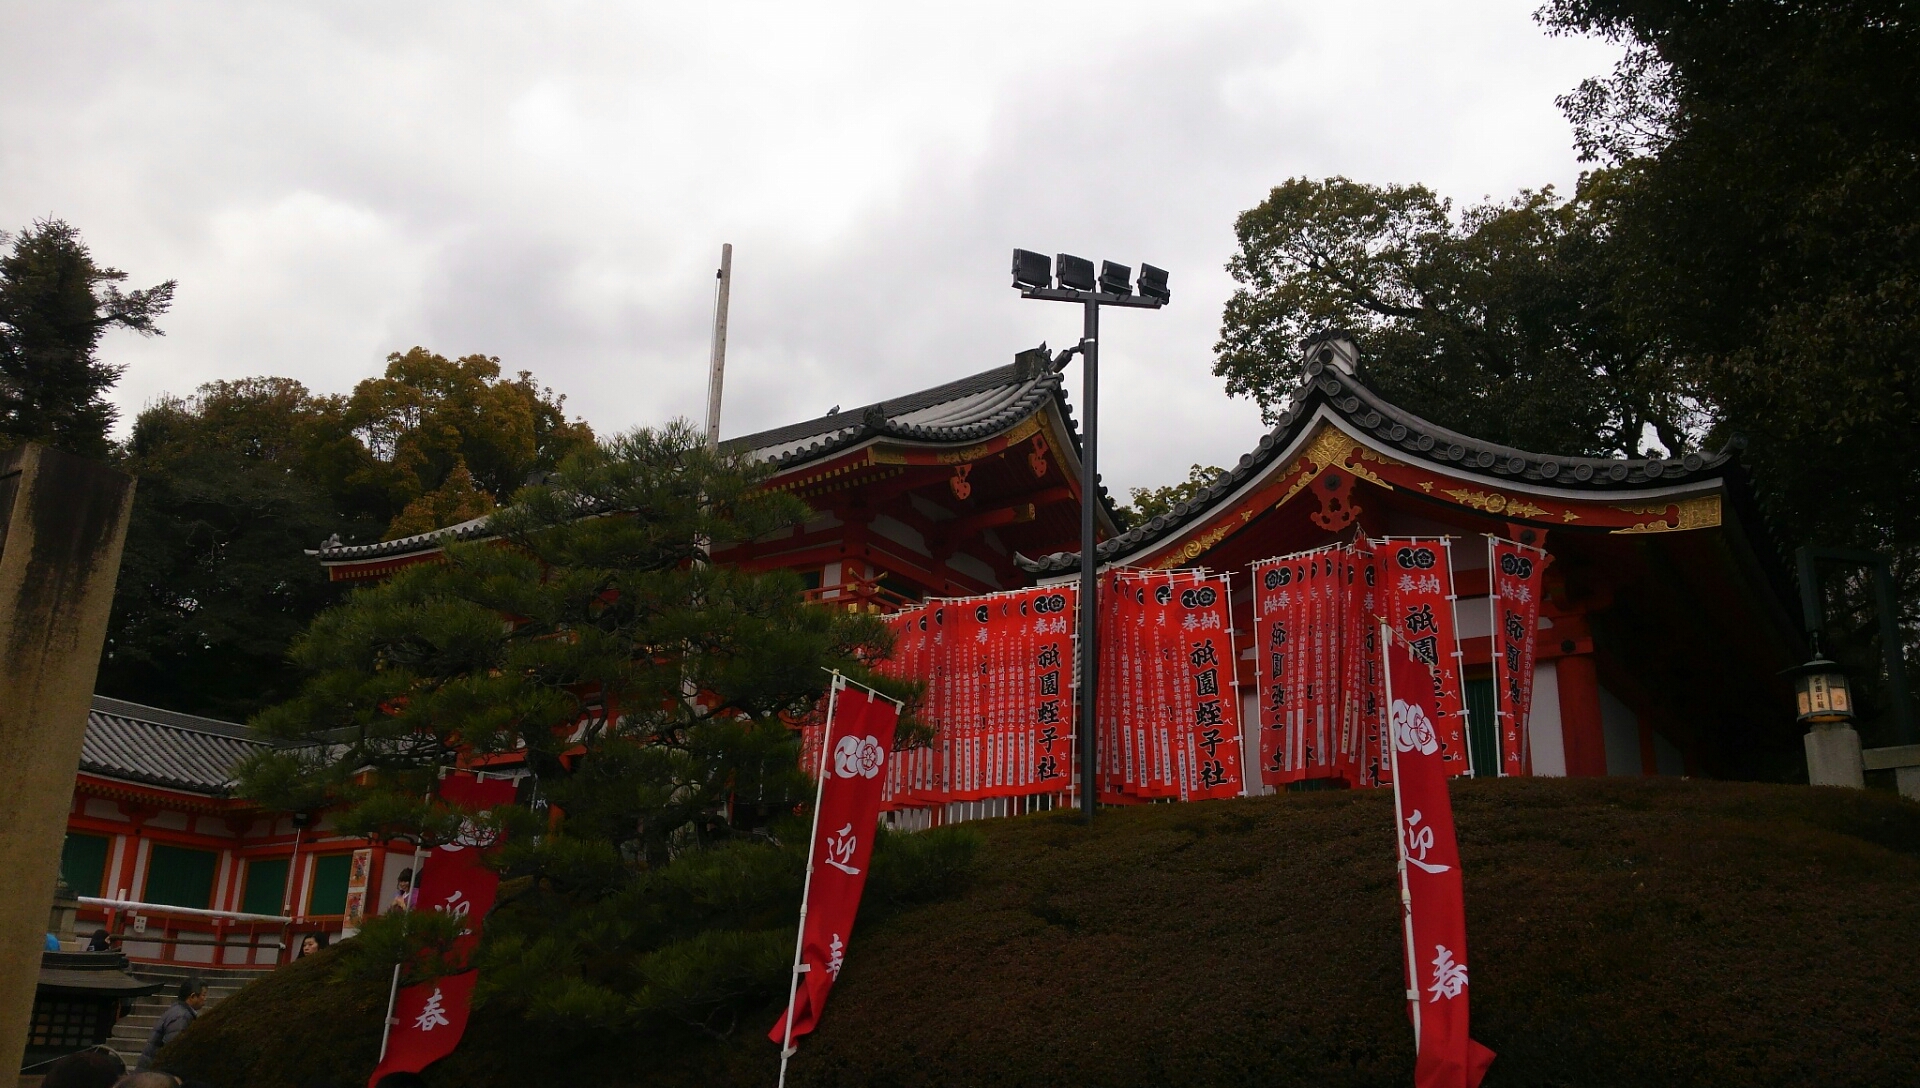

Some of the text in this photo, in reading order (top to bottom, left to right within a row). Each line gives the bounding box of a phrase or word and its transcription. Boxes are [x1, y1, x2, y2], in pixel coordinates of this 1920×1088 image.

[1033, 615, 1067, 636] 奉納
[1181, 610, 1220, 632] 奉納
[1397, 574, 1440, 595] 奉納
[1036, 642, 1062, 782] 祇園蛭子社
[1059, 699, 1069, 778] えべっさん
[1189, 638, 1229, 790] 祇園蛭子社
[1222, 698, 1237, 784] えべっさん
[1445, 669, 1463, 762] えべっさん
[1401, 808, 1469, 1004] 迎春
